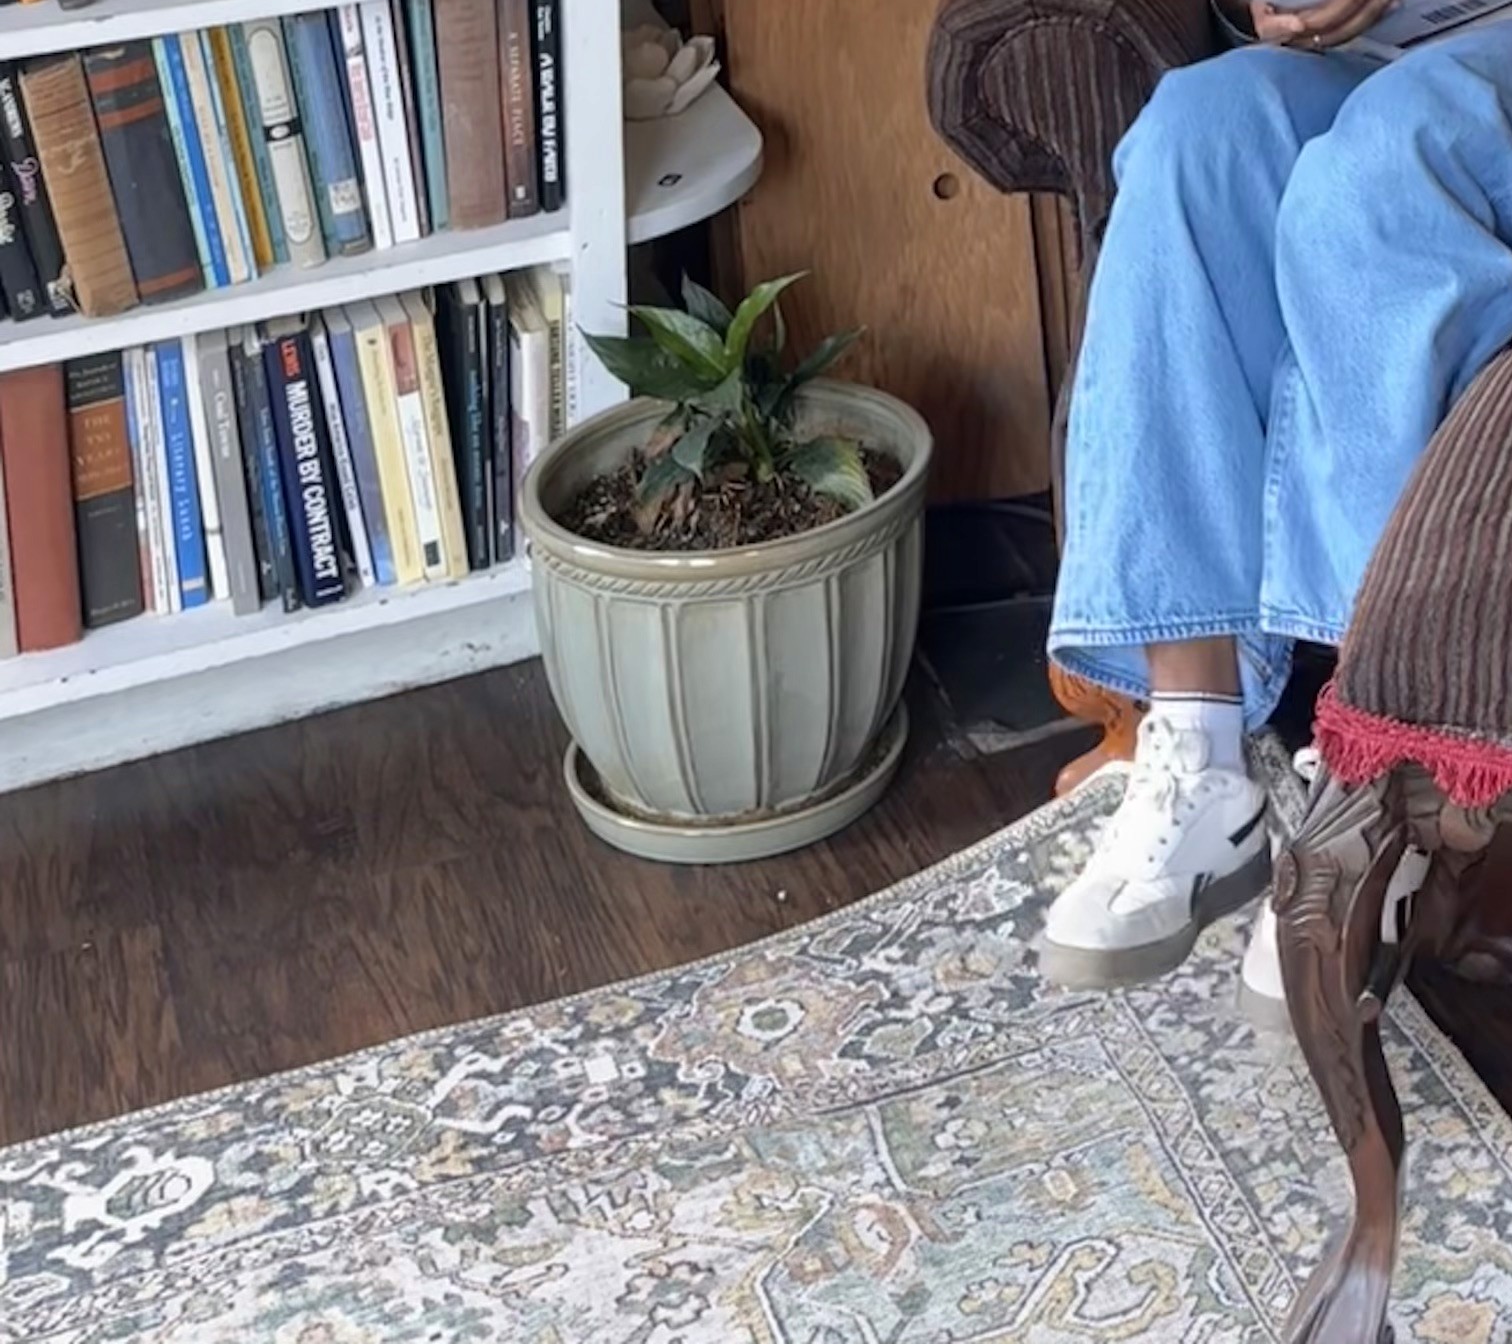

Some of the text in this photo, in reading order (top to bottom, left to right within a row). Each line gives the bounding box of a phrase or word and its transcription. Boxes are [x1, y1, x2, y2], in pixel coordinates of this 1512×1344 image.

[212, 391, 234, 460] Coal Towns
[279, 379, 345, 583] MURDER BY CONTRACT
[166, 431, 196, 542] Literary Lunch
